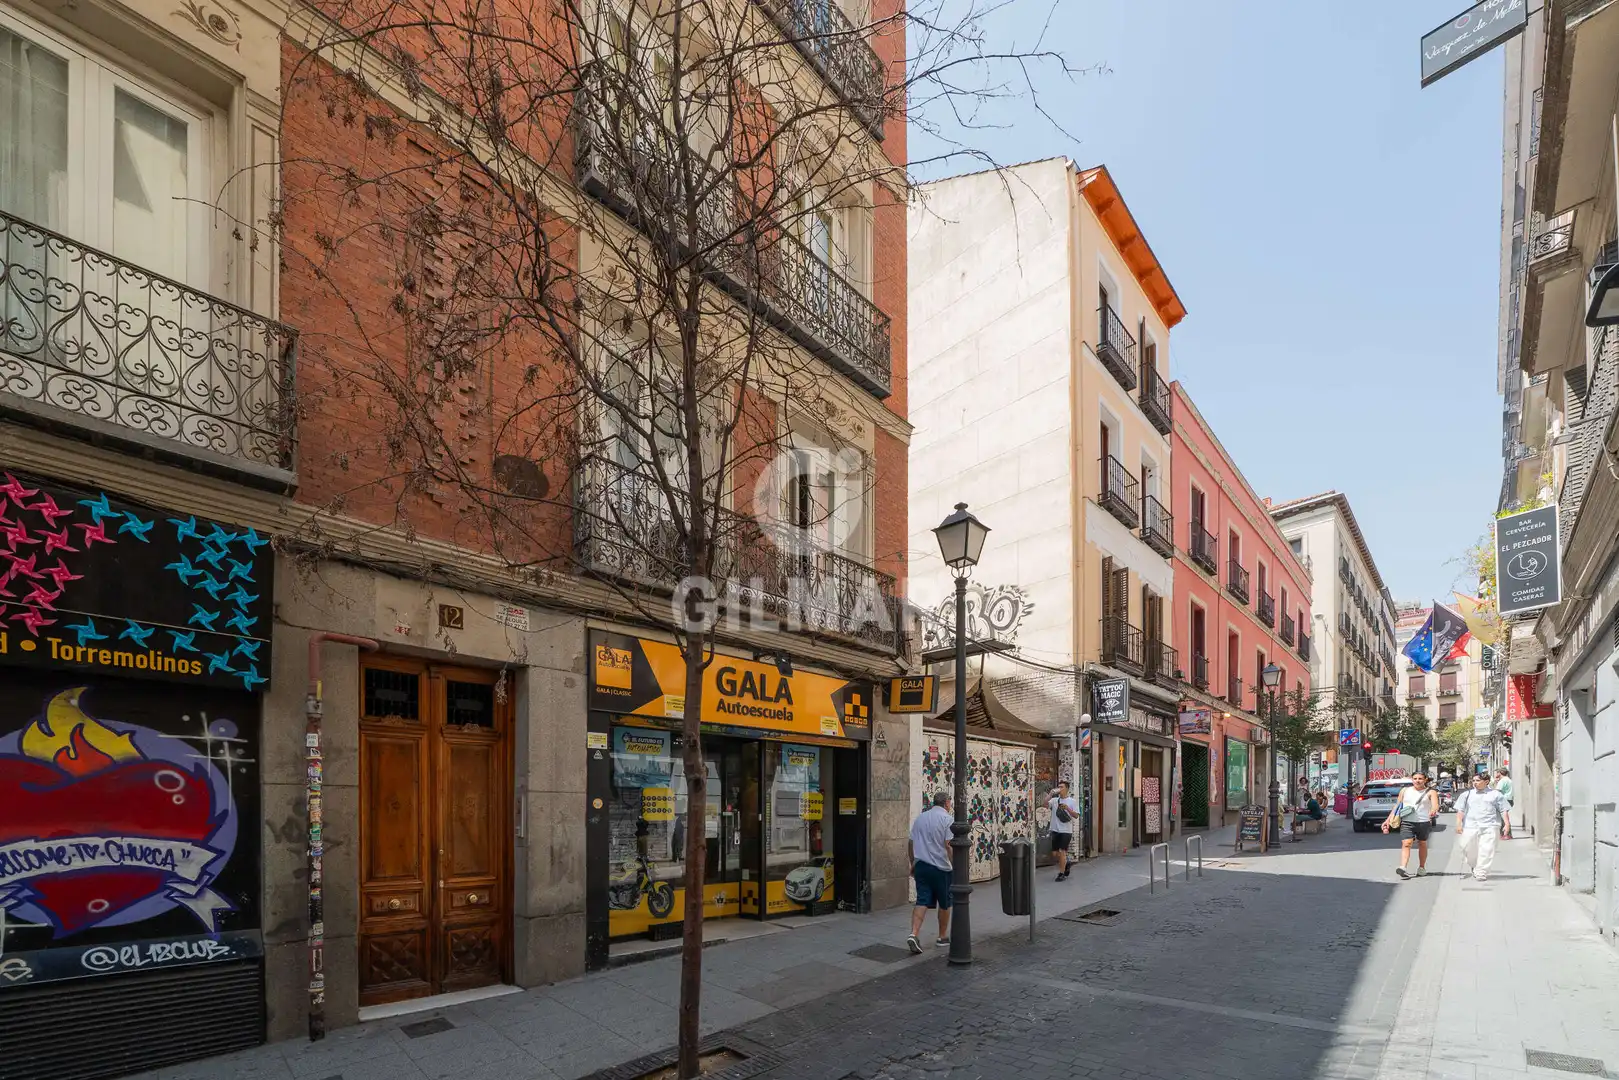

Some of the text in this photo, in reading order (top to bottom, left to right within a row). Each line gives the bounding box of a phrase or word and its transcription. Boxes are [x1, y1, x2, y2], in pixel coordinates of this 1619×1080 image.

[1505, 521, 1546, 536] CERVECERÍA
[1512, 534, 1552, 550] PEZCADOR
[1511, 586, 1545, 597] COMIDAS
[1512, 592, 1544, 603] CASERAS
[443, 606, 461, 628] 12
[47, 637, 202, 675] Torremolinos
[598, 650, 630, 664] GALA
[716, 666, 794, 706] GALA
[901, 680, 924, 689] GALA
[1098, 683, 1124, 692] TATTOO
[1101, 690, 1121, 699] MAGIC
[1508, 676, 1517, 720] MERCADO
[716, 698, 794, 722] Autoescuela
